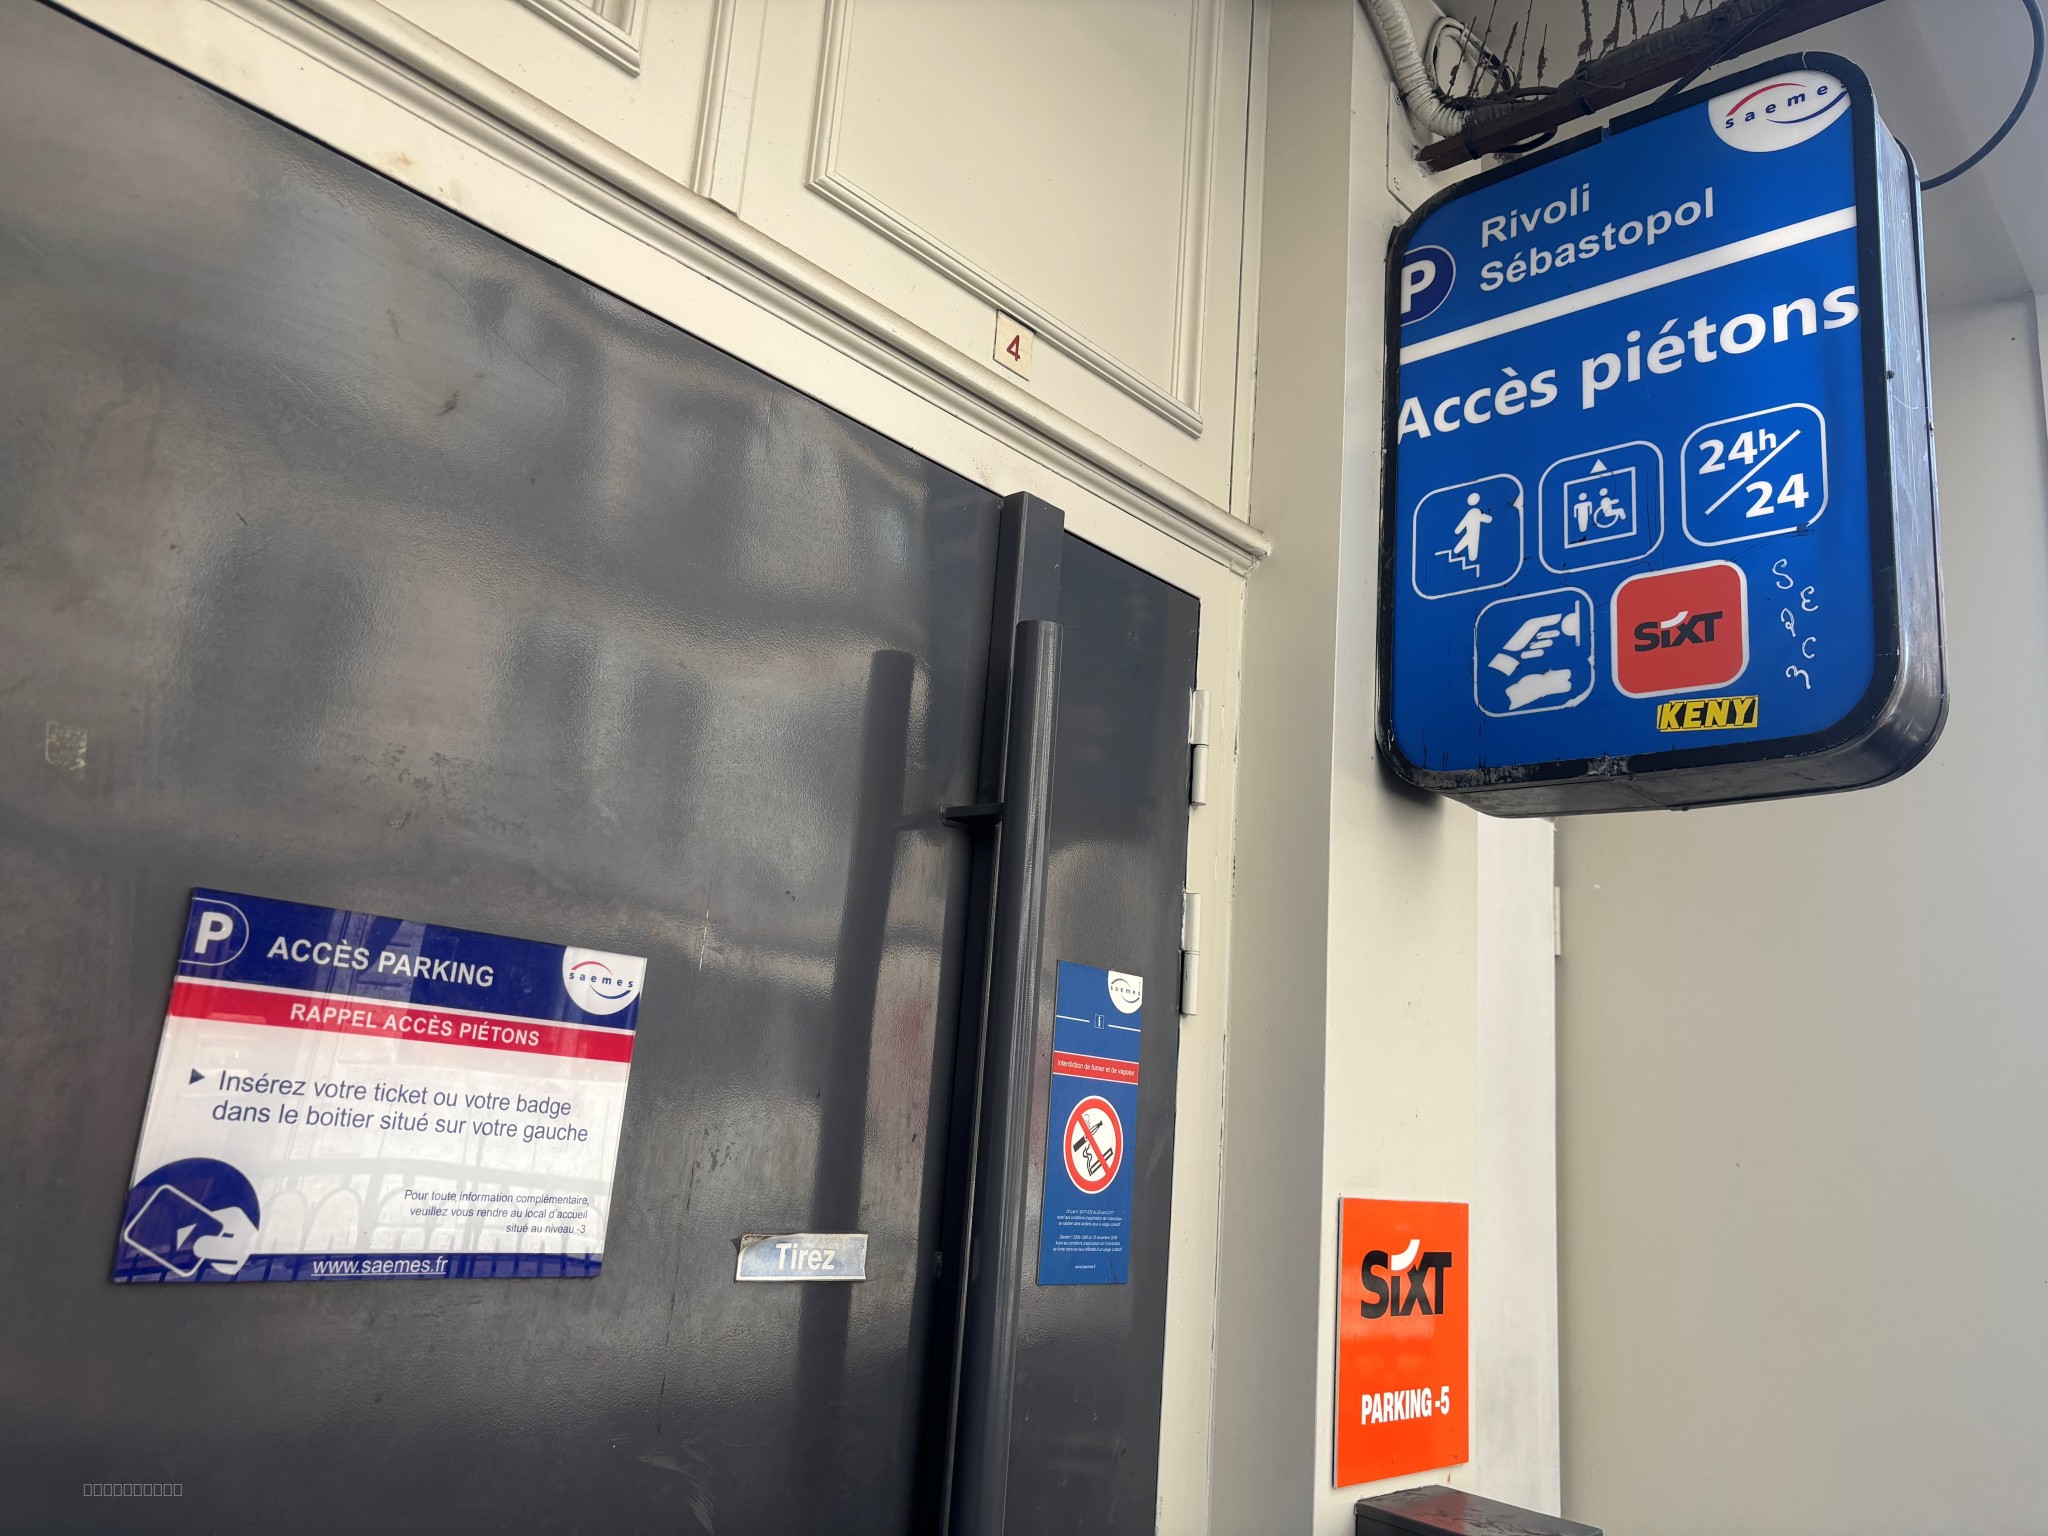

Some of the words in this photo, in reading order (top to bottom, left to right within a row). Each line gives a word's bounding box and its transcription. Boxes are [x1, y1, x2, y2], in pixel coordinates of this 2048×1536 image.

[1725, 83, 1847, 128] saeme
[1481, 182, 1591, 249] Rivoli
[1480, 186, 1715, 292] Sébastopol
[1401, 259, 1437, 314] P
[1006, 334, 1021, 362] 4
[1397, 366, 1559, 445] Accès
[1581, 284, 1860, 410] piétons
[1659, 696, 1755, 730] KENY
[194, 911, 234, 954] P
[266, 936, 370, 970] ACCÈS
[377, 951, 495, 988] PARKING
[568, 970, 634, 989] saemes
[289, 1003, 378, 1030] RAPPEL
[383, 1014, 453, 1037] ACCÈS
[458, 1020, 540, 1047] PIÉTONS
[1057, 1058, 1084, 1069] Interdiction
[1091, 1063, 1105, 1072] fumer
[1111, 1066, 1117, 1074] de
[218, 1069, 307, 1096] Insérez
[314, 1080, 367, 1100] votre
[373, 1083, 428, 1105] ticket
[433, 1091, 458, 1107] ou
[465, 1092, 511, 1111] votre
[516, 1094, 571, 1119] badge
[212, 1099, 271, 1123] dans
[278, 1103, 299, 1125] le
[305, 1105, 375, 1129] boitier
[379, 1110, 429, 1132] situé
[434, 1117, 467, 1134] sur
[473, 1119, 518, 1138] votre
[522, 1123, 588, 1143] gauche
[404, 1189, 429, 1200] Pour
[459, 1190, 513, 1203] information
[516, 1193, 590, 1206] complémentaire,
[410, 1205, 448, 1217] veuillez
[451, 1208, 474, 1217] vous
[476, 1207, 508, 1218] rendre
[510, 1210, 523, 1218] au
[525, 1208, 547, 1218] local
[549, 1208, 588, 1219] d'accueil
[506, 1222, 529, 1233] situé
[530, 1225, 543, 1233] au
[545, 1223, 575, 1234] niveau
[576, 1224, 586, 1234] -3
[311, 1255, 448, 1275] www.saemes.fr
[775, 1242, 836, 1270] Tirez
[1361, 1387, 1433, 1425] PARKING
[1434, 1386, 1450, 1415] -5
